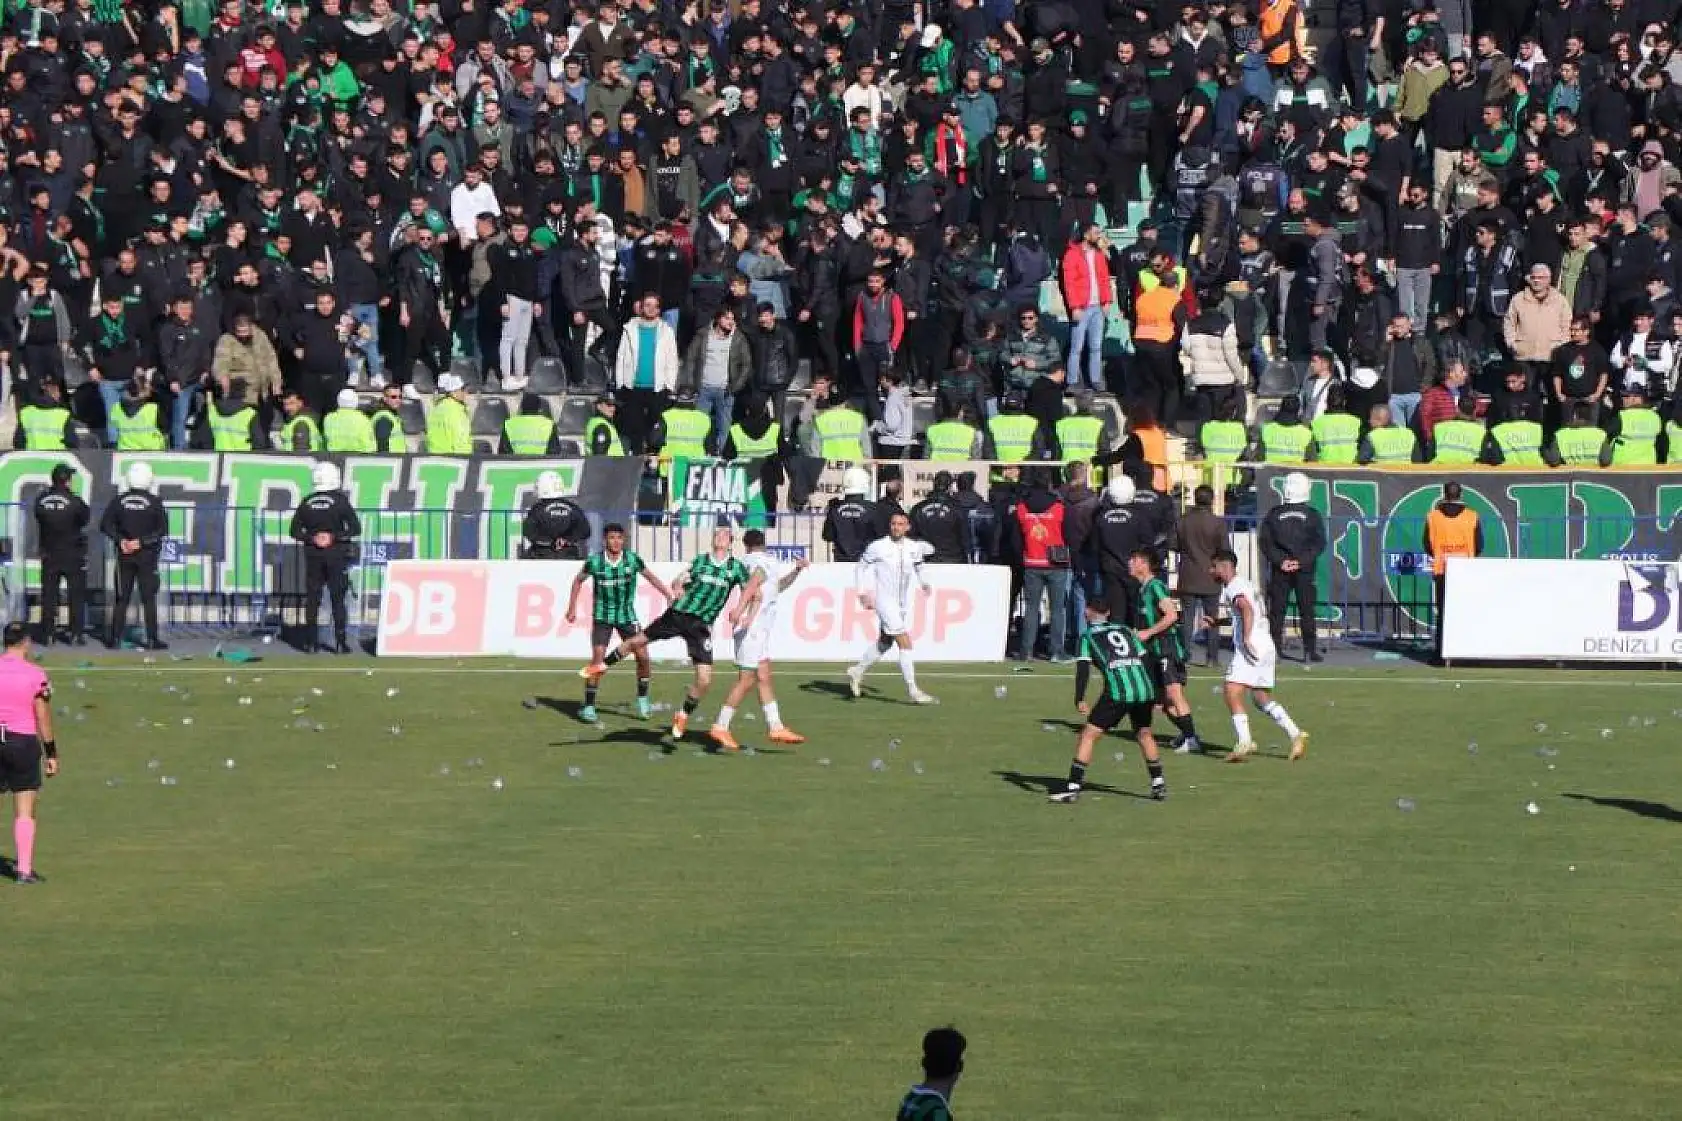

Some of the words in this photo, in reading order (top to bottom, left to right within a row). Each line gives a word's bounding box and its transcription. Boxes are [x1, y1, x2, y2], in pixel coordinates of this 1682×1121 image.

[685, 464, 746, 503] FANA
[1617, 579, 1682, 632] D
[1107, 630, 1130, 657] 9
[1582, 635, 1660, 653] DENİZLİ
